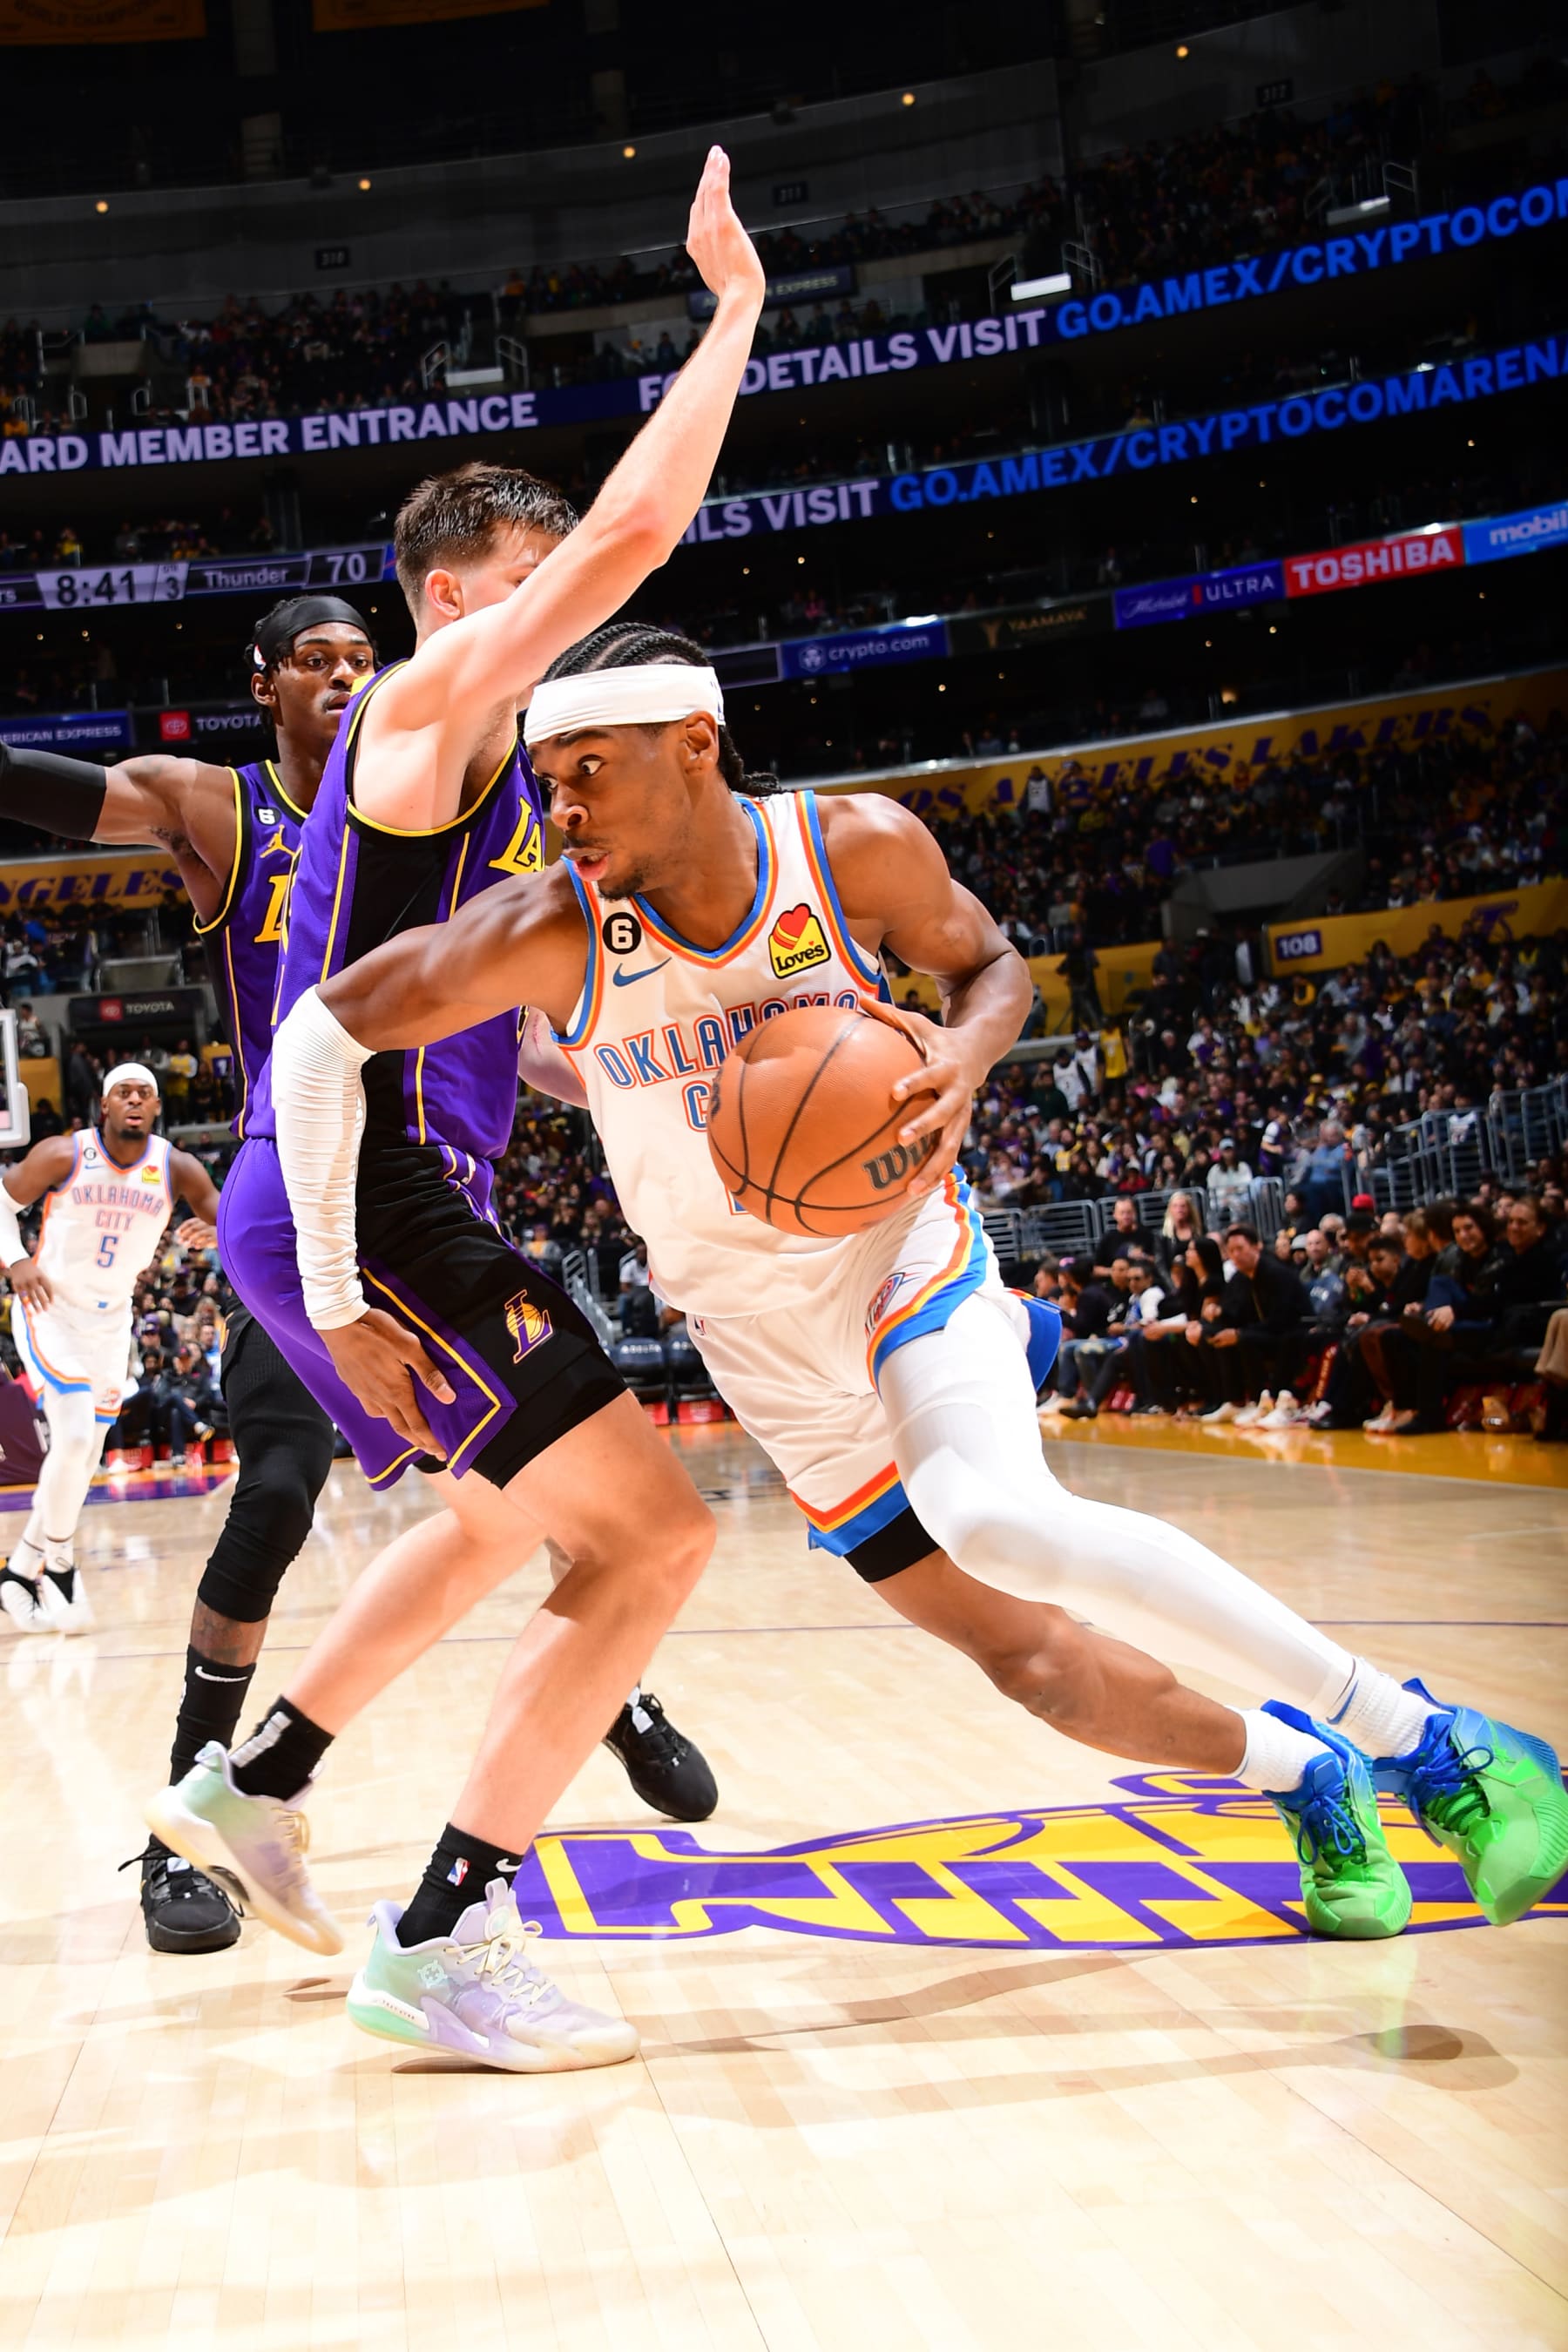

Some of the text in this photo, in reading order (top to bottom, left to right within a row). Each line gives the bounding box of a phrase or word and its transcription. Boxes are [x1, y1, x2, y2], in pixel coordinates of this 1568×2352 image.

[775, 276, 837, 295] EXPRESS
[740, 333, 918, 396] DETAILS
[927, 308, 1046, 363] VISIT
[100, 420, 290, 469] MEMBER
[301, 393, 538, 452] ENTRANCE
[760, 479, 880, 531] VISIT
[889, 335, 1568, 512] GO.AMEX/CRYPTOCOMAREN
[325, 551, 367, 585] 70
[1291, 536, 1456, 590] TOSHIBA
[57, 570, 135, 605] 8:41
[166, 577, 179, 600] 3
[203, 567, 290, 589] Thunder
[1205, 573, 1276, 604] ULTRA
[828, 634, 930, 661] crypto.com
[0, 725, 122, 744] ERICAN EXPRESS
[196, 713, 261, 733] TOYOTA
[258, 808, 275, 825] 6
[611, 917, 635, 949] 6
[1279, 934, 1319, 958] 108
[125, 999, 175, 1015] TOYOTA
[72, 1184, 164, 1217] OKLAHOMA
[95, 1208, 134, 1232] CITY
[97, 1233, 119, 1269] 5
